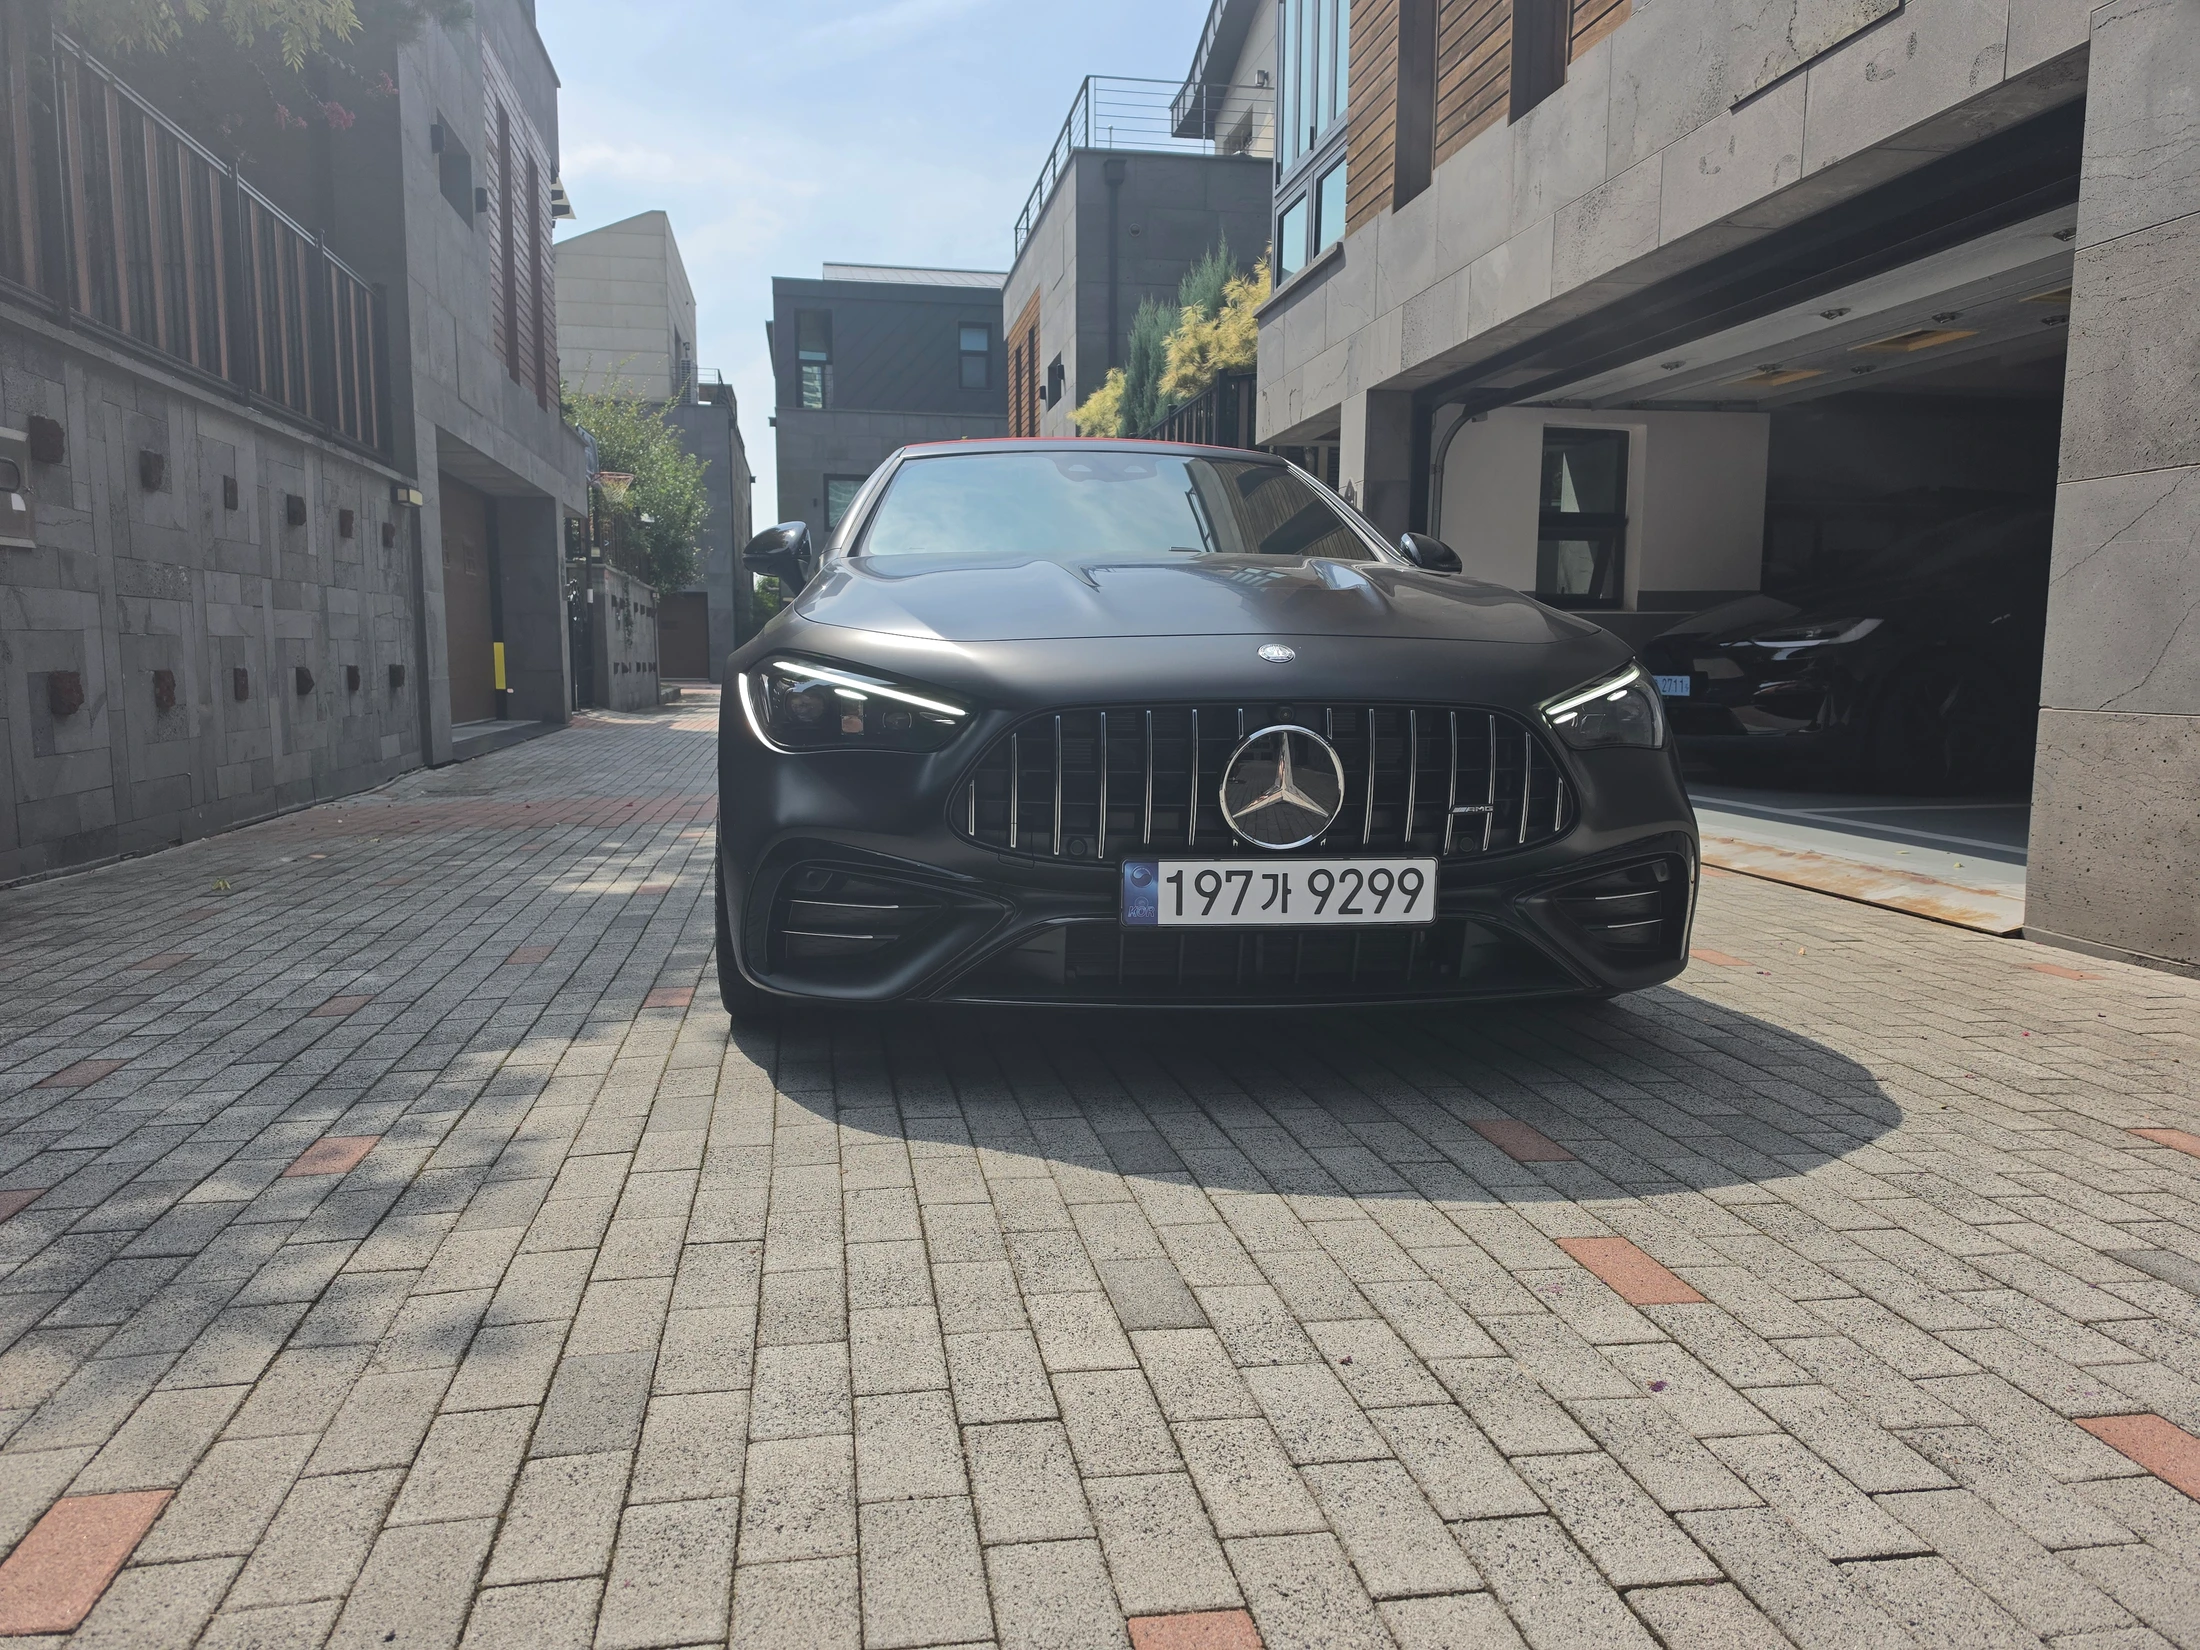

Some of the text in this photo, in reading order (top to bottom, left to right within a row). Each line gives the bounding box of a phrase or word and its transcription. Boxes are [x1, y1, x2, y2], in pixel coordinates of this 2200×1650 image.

[1661, 678, 1684, 693] 2711
[1166, 867, 1425, 917] 197가 9299
[1127, 905, 1155, 918] KOR
